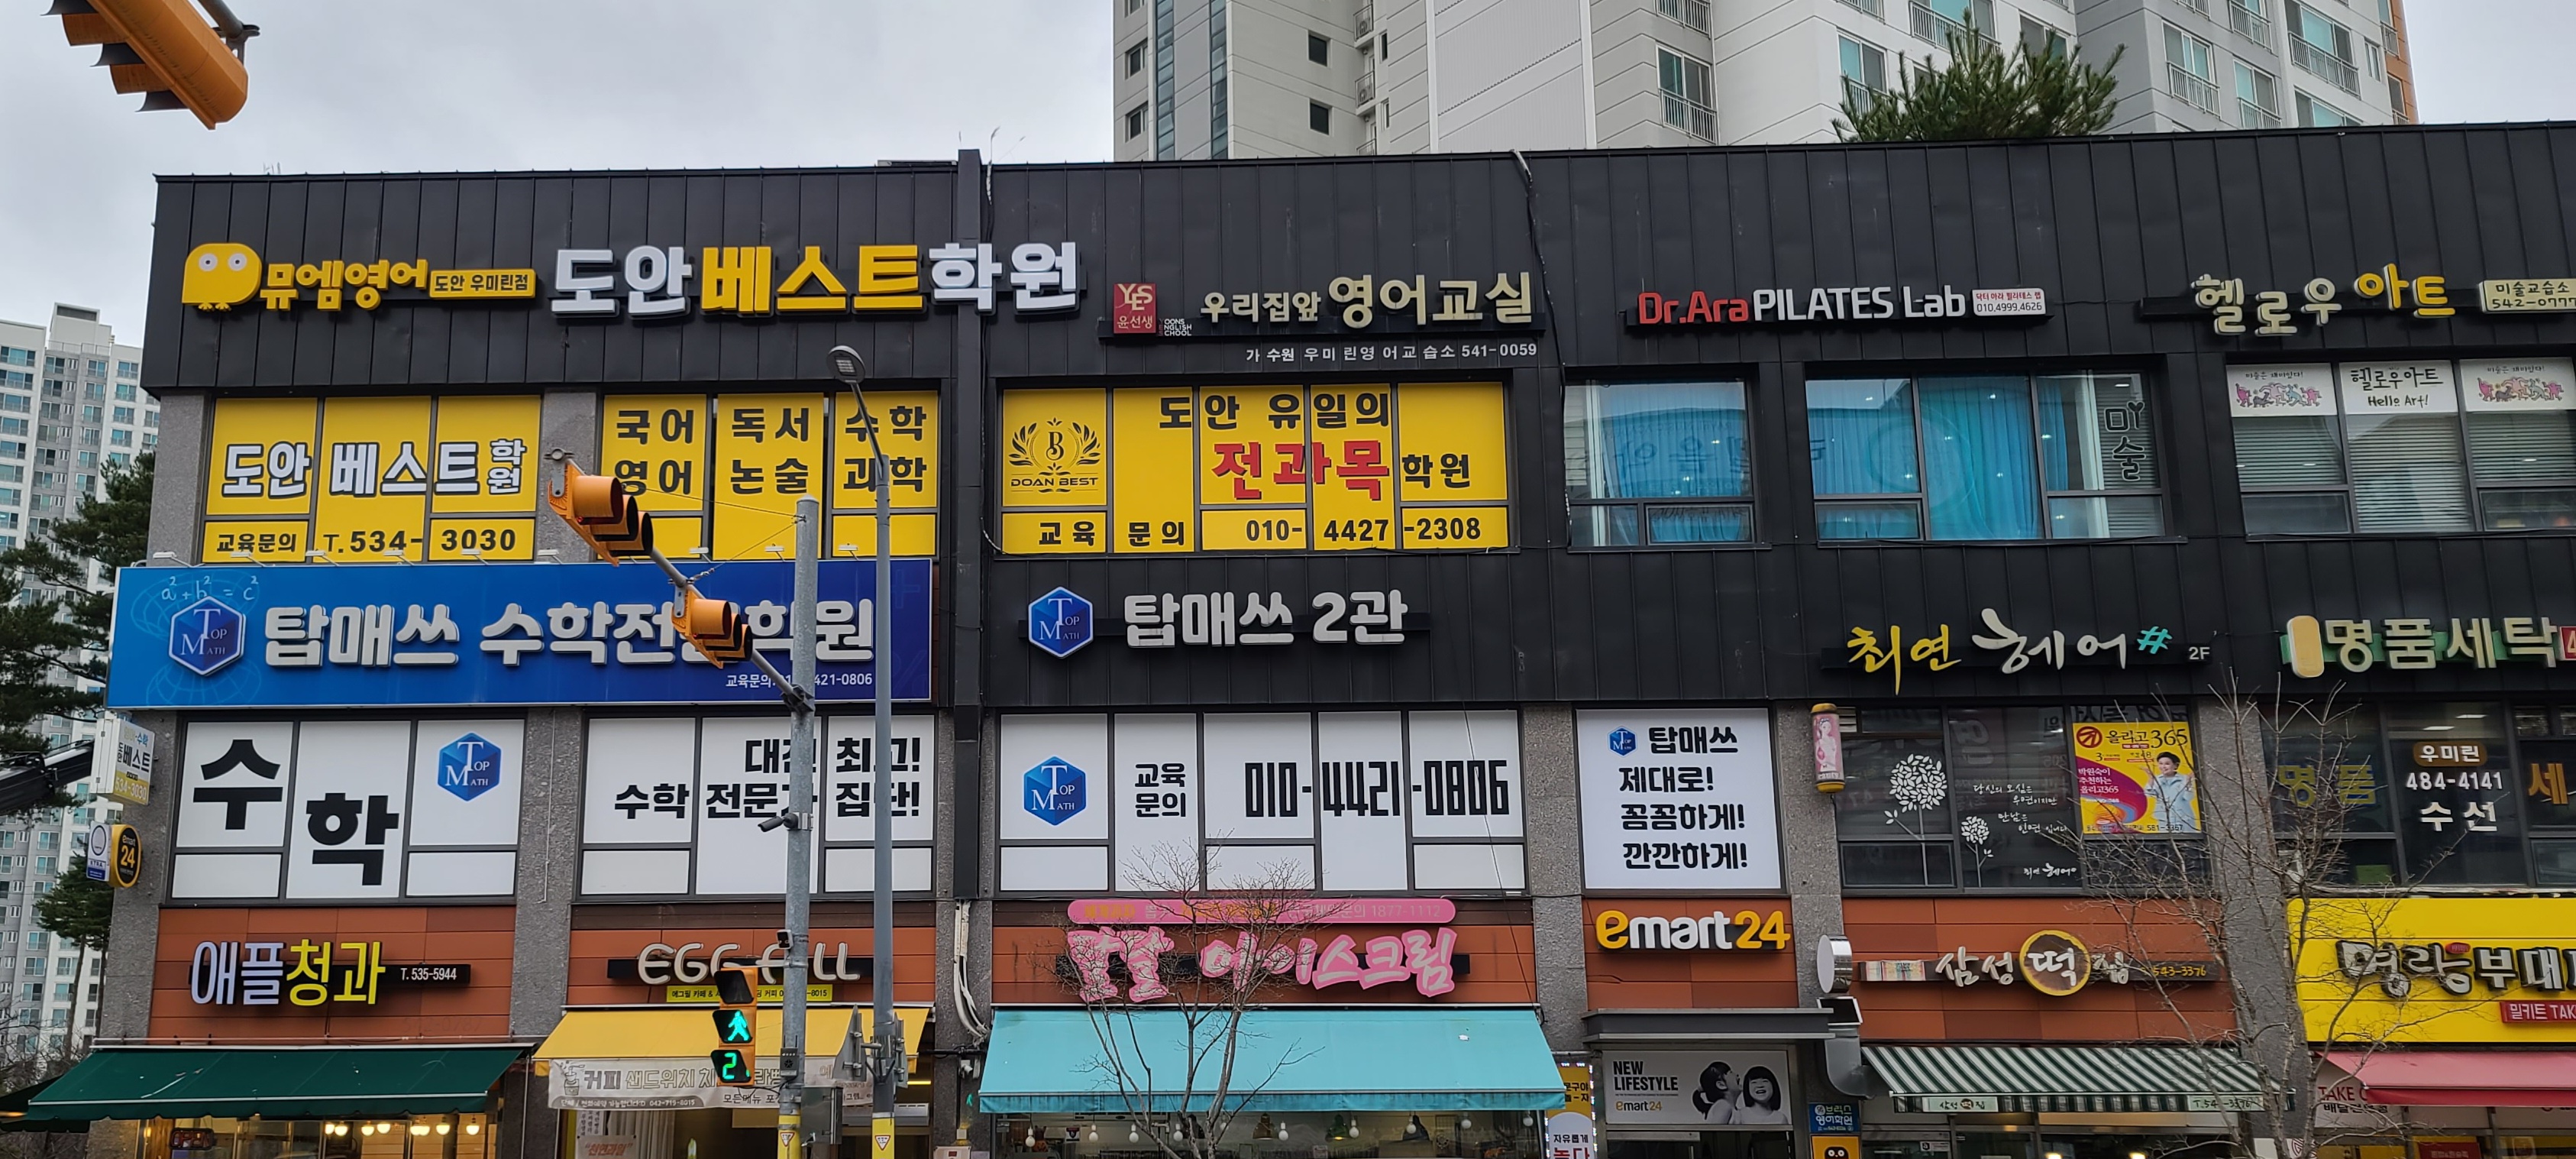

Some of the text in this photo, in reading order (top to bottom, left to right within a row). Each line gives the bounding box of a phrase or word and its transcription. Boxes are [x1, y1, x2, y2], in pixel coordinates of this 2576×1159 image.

[260, 260, 428, 310] 뮤엠영어
[434, 273, 528, 293] 도안 우미린점
[1990, 292, 2004, 300] 아라
[2496, 281, 2569, 296] 미술교습소
[1200, 271, 1533, 329] 우리집앞 영어교실
[1902, 284, 1967, 319] Lab
[1976, 302, 2042, 312] 010.4999.4626
[2190, 263, 2456, 335] 헬로우 아트
[1117, 316, 1153, 329] 윤선생
[1461, 343, 1538, 358] 541-0059
[1159, 392, 1390, 430] 도안 유일의
[2368, 393, 2429, 409] Hello Art!
[616, 409, 695, 446] 국어
[731, 406, 810, 445] 독서
[221, 441, 313, 498] 도안
[330, 441, 480, 497] 베스트
[614, 458, 693, 497] 영어
[730, 458, 810, 495] 논술
[1010, 477, 1099, 487] DOAN BEST
[1212, 440, 1471, 500] 전과목 학원
[216, 533, 297, 554] 교육문의
[1124, 589, 1409, 648] 탑매쓰 2관
[264, 597, 874, 669] 탑매쓰 수학전학원
[2324, 617, 2558, 672] 명품세탁
[1847, 623, 1963, 695] 최연
[2189, 646, 2211, 661] 2F
[1648, 726, 1739, 755] 탑매쓰
[122, 743, 150, 773] 베스트
[2419, 746, 2481, 764] 우미린
[1135, 762, 1187, 788] 교육
[1618, 766, 1715, 793] 제대로!
[2406, 772, 2503, 790] 484-4141
[614, 783, 690, 819] 수학
[1973, 783, 2002, 795] 당신의
[1135, 792, 1187, 817] 문의
[1620, 803, 1746, 831] 꼼꼼하게!
[2419, 800, 2498, 832] 수선
[121, 844, 136, 869] 24
[1622, 842, 1748, 869] 깐깐하게!
[190, 937, 386, 1006] 애플청과
[1200, 927, 1458, 999] 아이스크림
[2335, 939, 2576, 998] 명랑부대
[2510, 1003, 2549, 1020] 밀키트
[584, 1069, 695, 1090] 커피 샌드위치
[1612, 1060, 1644, 1076] NEW
[1614, 1076, 1679, 1091] LIFESTYLE
[1553, 1135, 1589, 1144] 자유롭게
